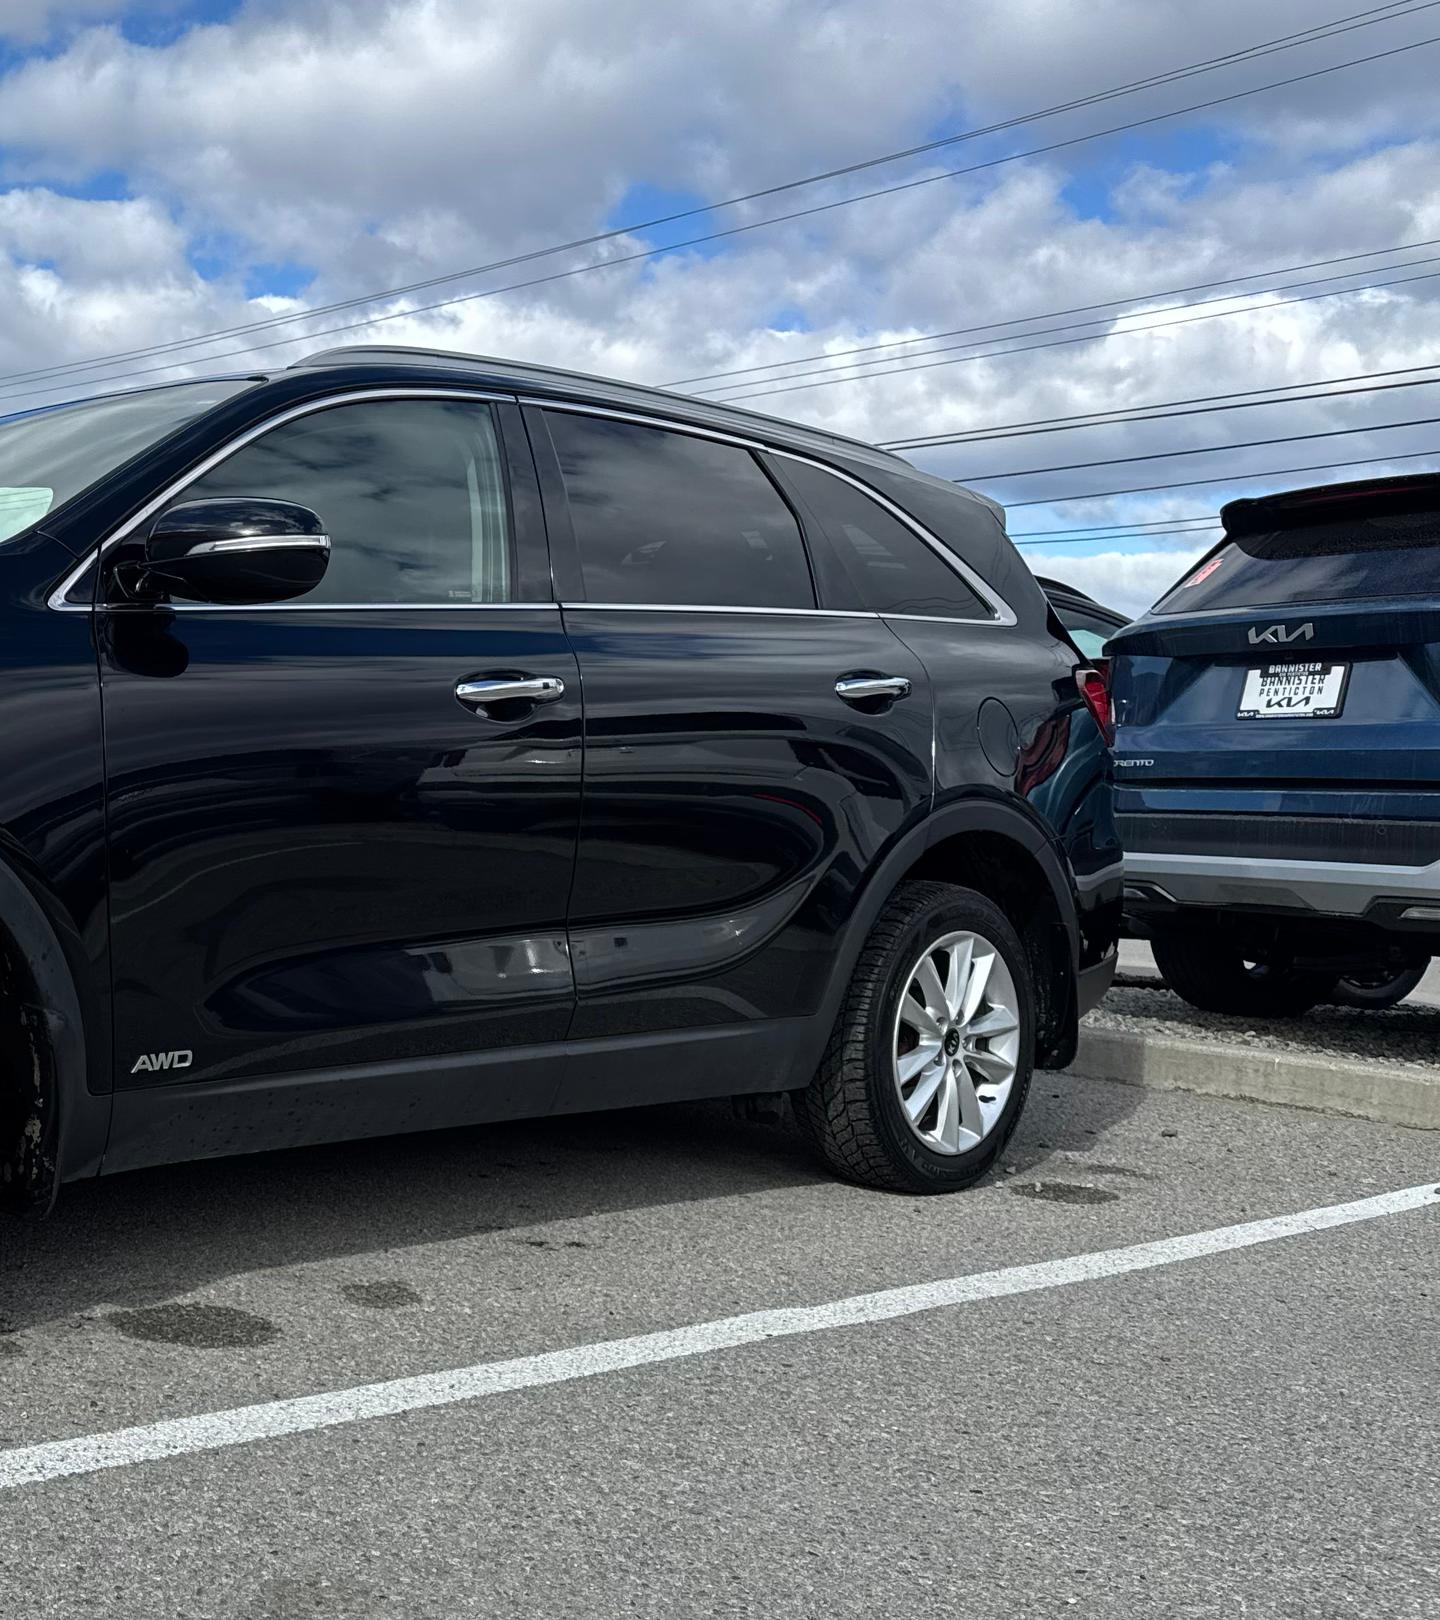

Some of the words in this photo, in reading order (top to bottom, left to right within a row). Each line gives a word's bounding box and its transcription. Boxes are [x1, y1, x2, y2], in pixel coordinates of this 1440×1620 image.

[1248, 623, 1314, 644] KIA
[1269, 663, 1322, 673] BANNISTER
[1261, 674, 1325, 687] BANNISTER
[1259, 686, 1324, 697] PENTICTON
[1266, 696, 1311, 708] KIA
[131, 1050, 192, 1073] AWD
